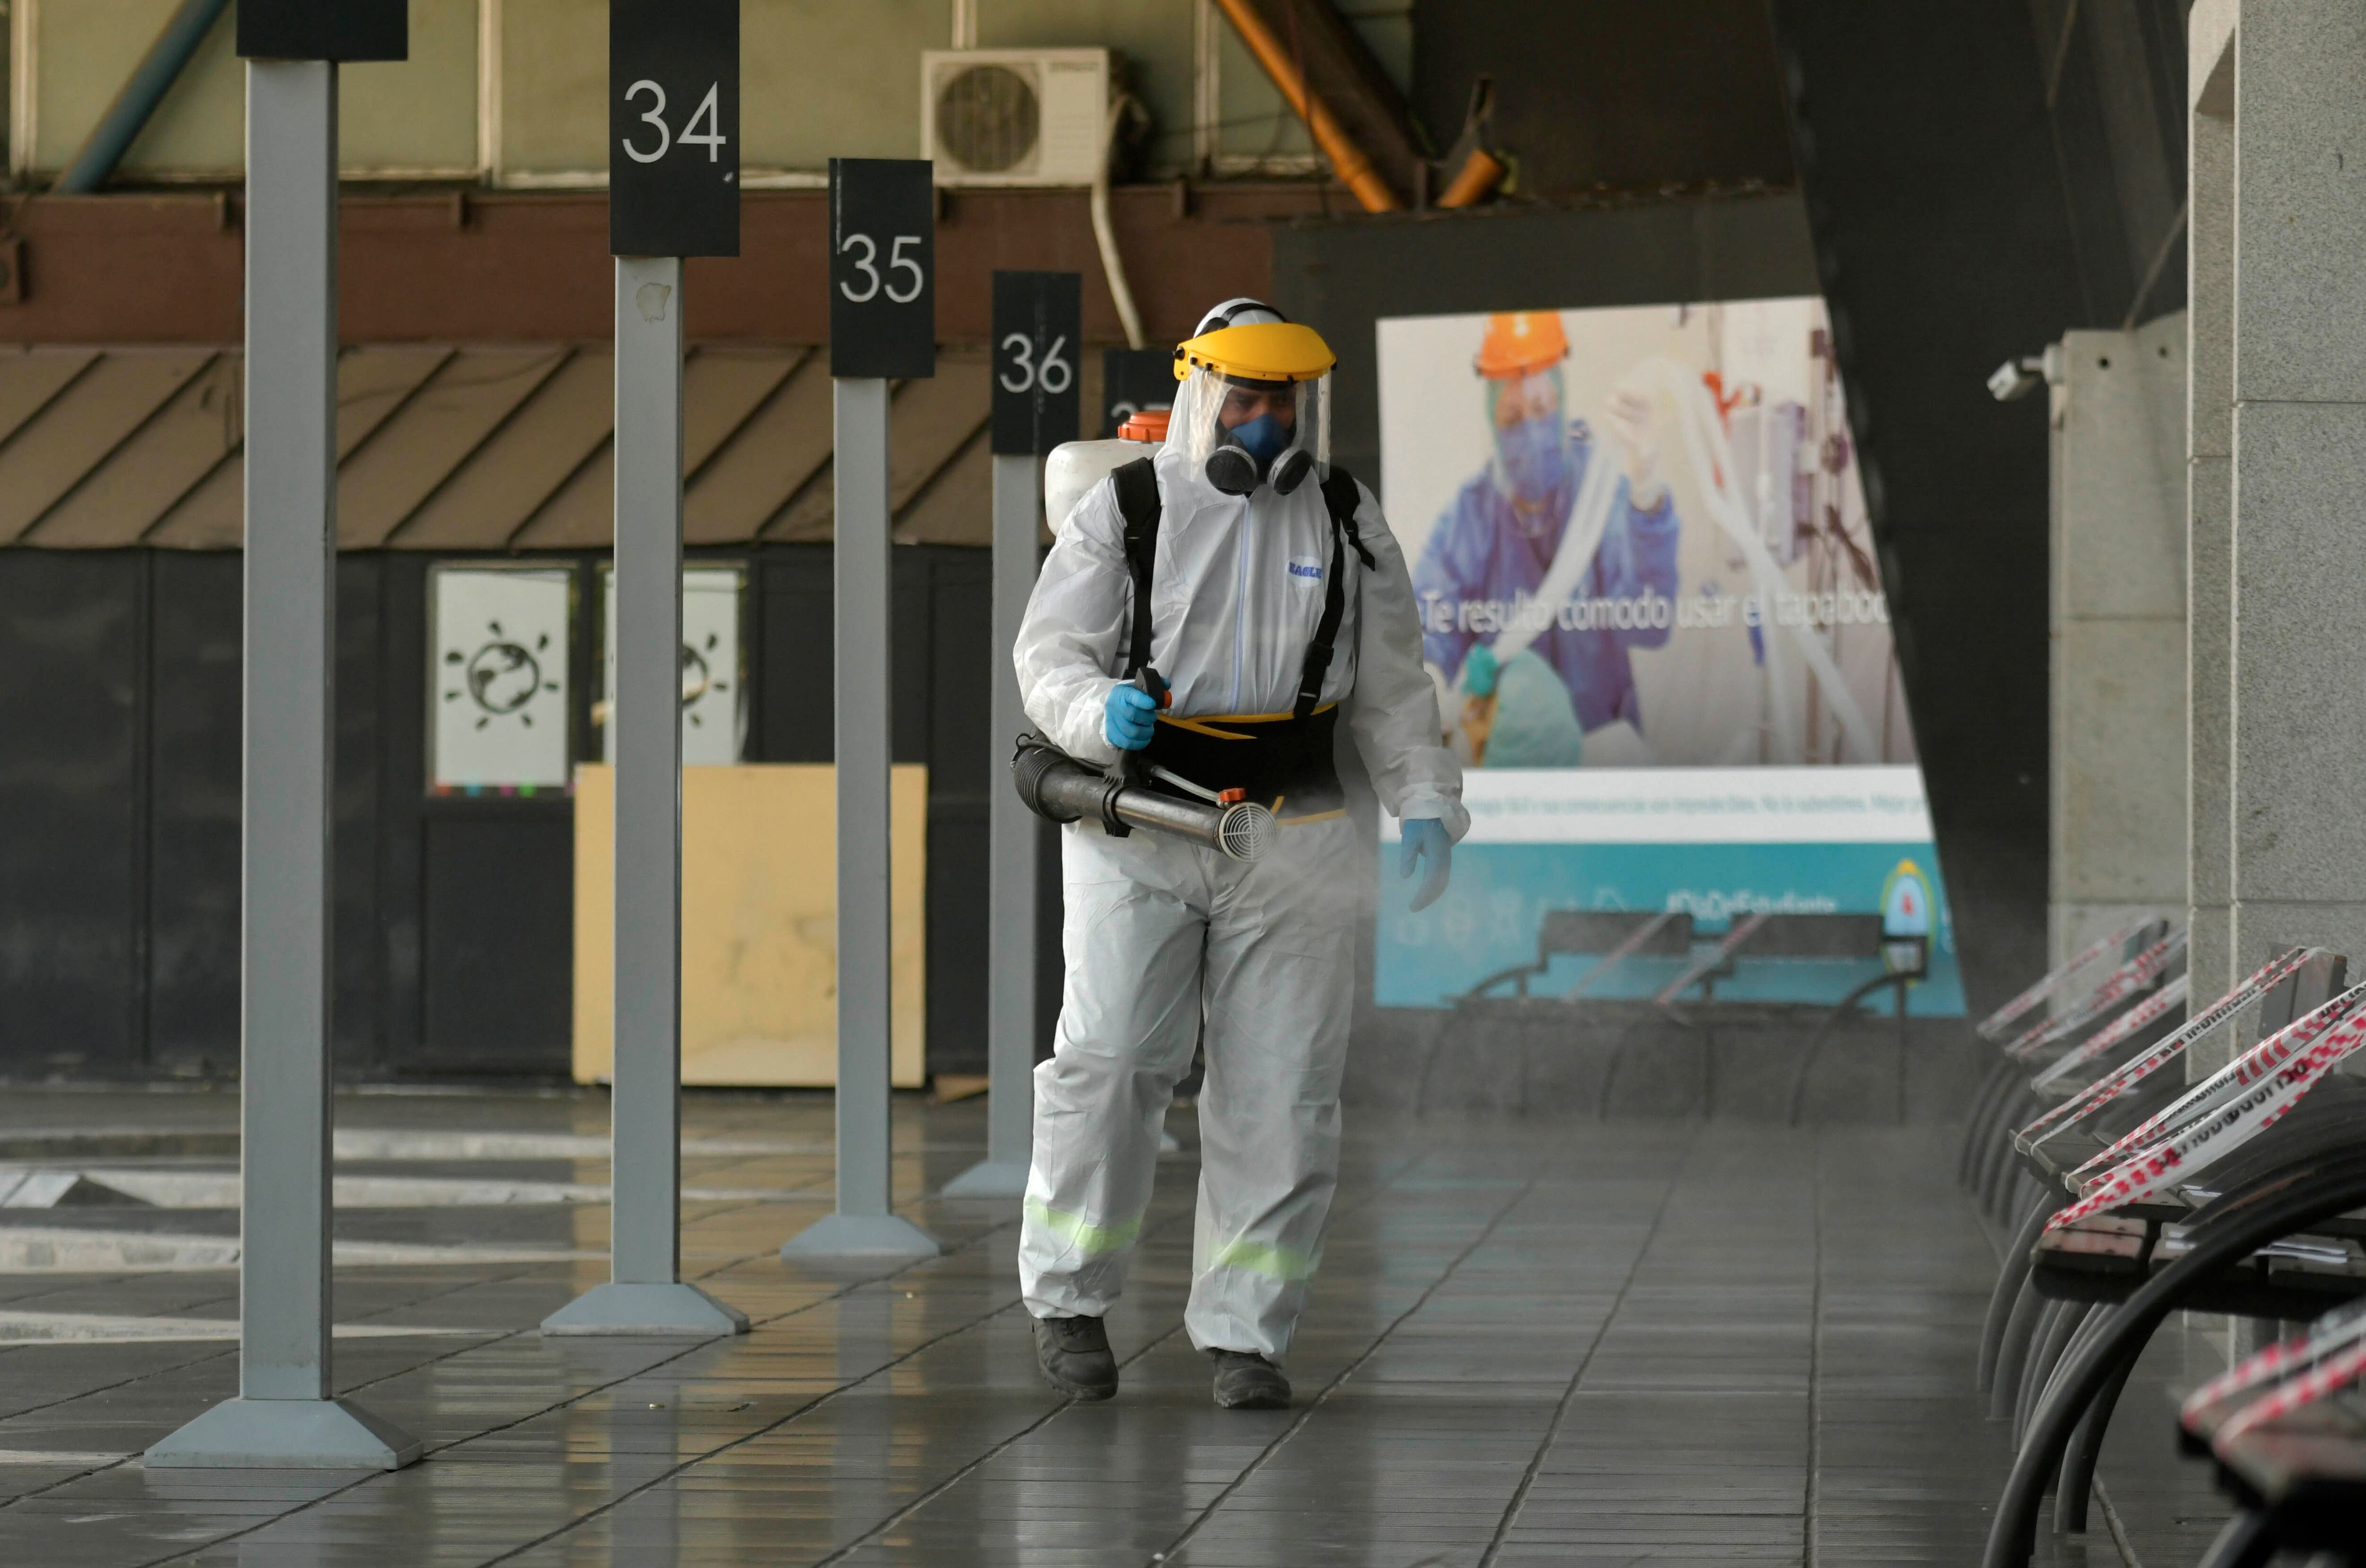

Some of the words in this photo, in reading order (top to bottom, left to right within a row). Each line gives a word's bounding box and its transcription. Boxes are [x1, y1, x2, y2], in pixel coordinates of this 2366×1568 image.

[622, 79, 726, 163] 34
[840, 234, 924, 303] 35
[1000, 333, 1072, 394] 36
[1421, 590, 1454, 634] Te
[1677, 594, 1736, 629] usar
